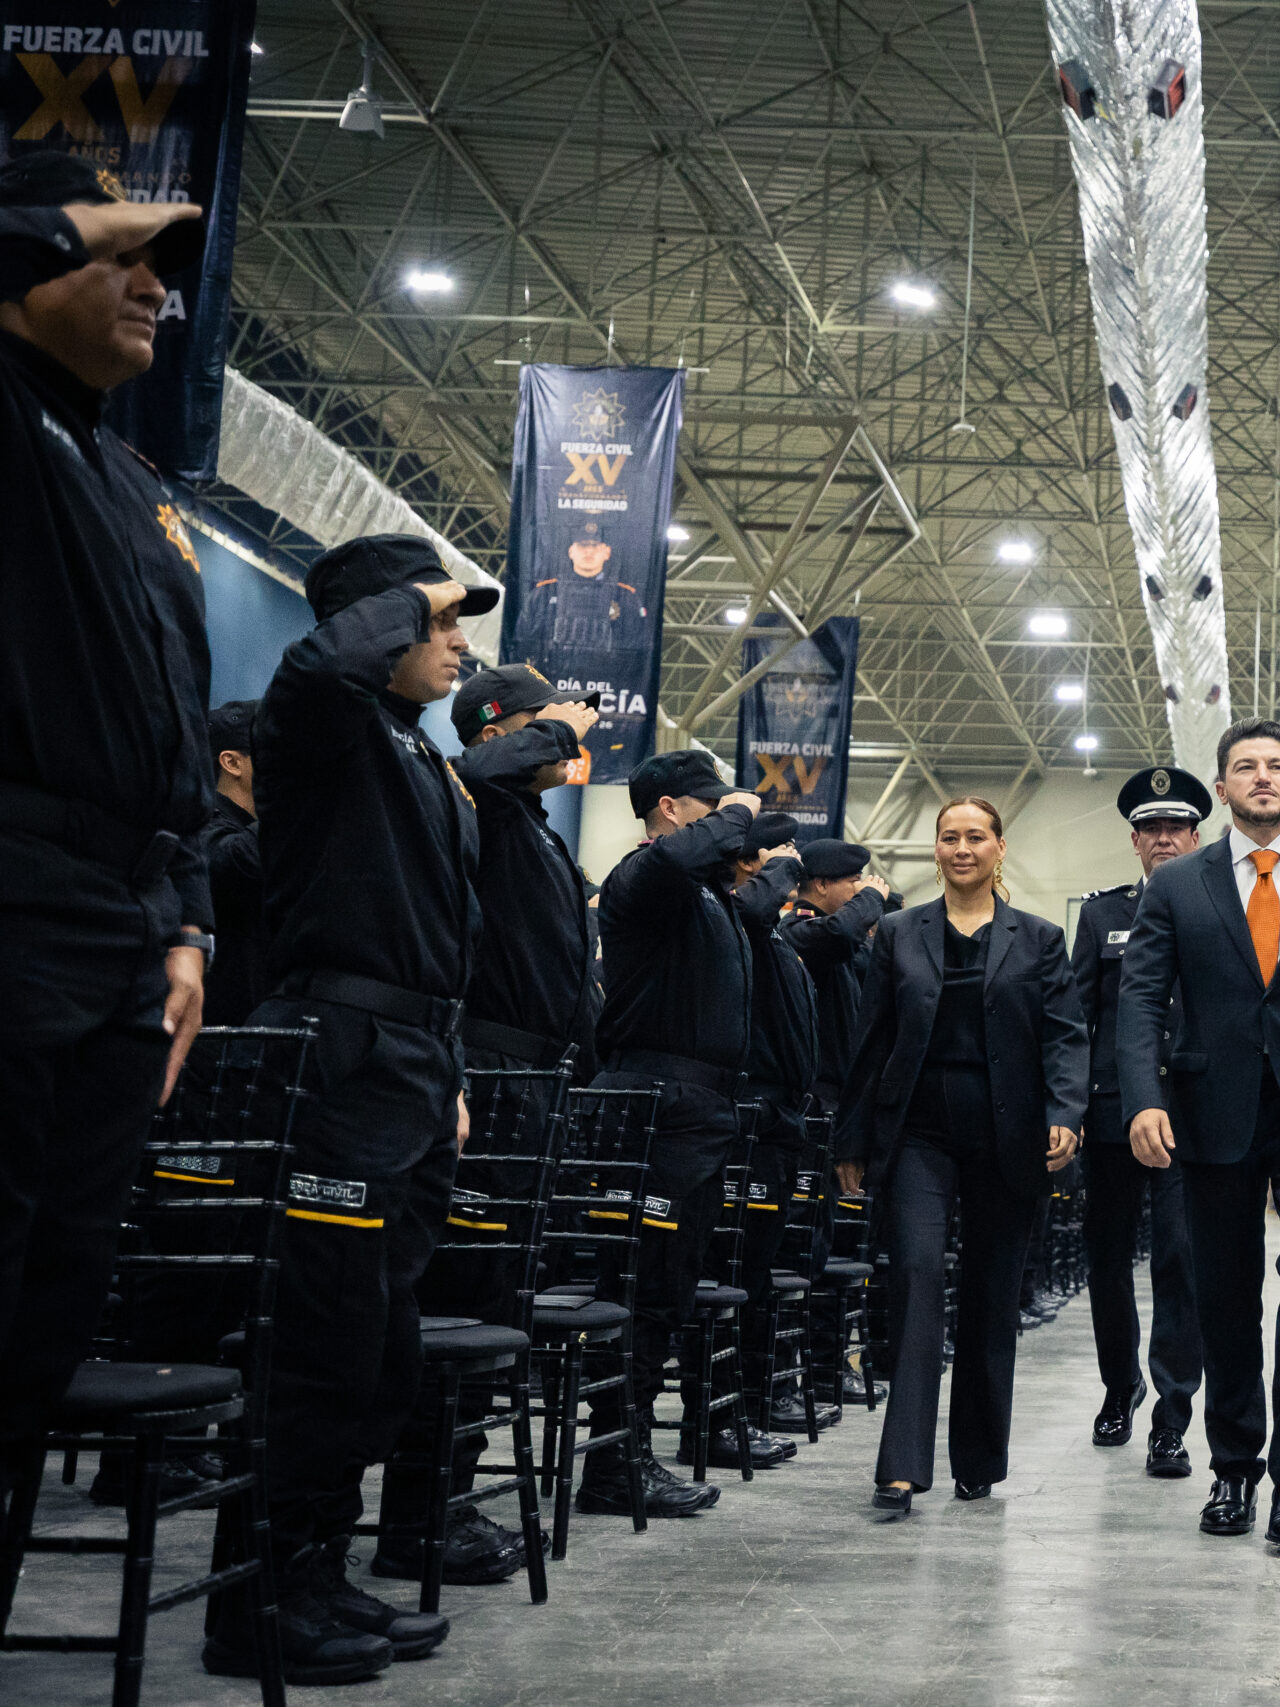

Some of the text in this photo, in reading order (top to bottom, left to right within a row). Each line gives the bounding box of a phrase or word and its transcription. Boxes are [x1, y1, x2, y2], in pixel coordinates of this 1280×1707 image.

[3, 25, 209, 57] FUERZA CIVIL
[12, 53, 192, 143] XV
[561, 442, 633, 456] FUERZA CIVIL
[564, 452, 627, 487] XV
[558, 498, 628, 511] LA SEGURIDAD
[557, 677, 614, 692] DÍA DEL
[750, 742, 834, 756] FUERZA CIVIL
[755, 753, 828, 795] XV
